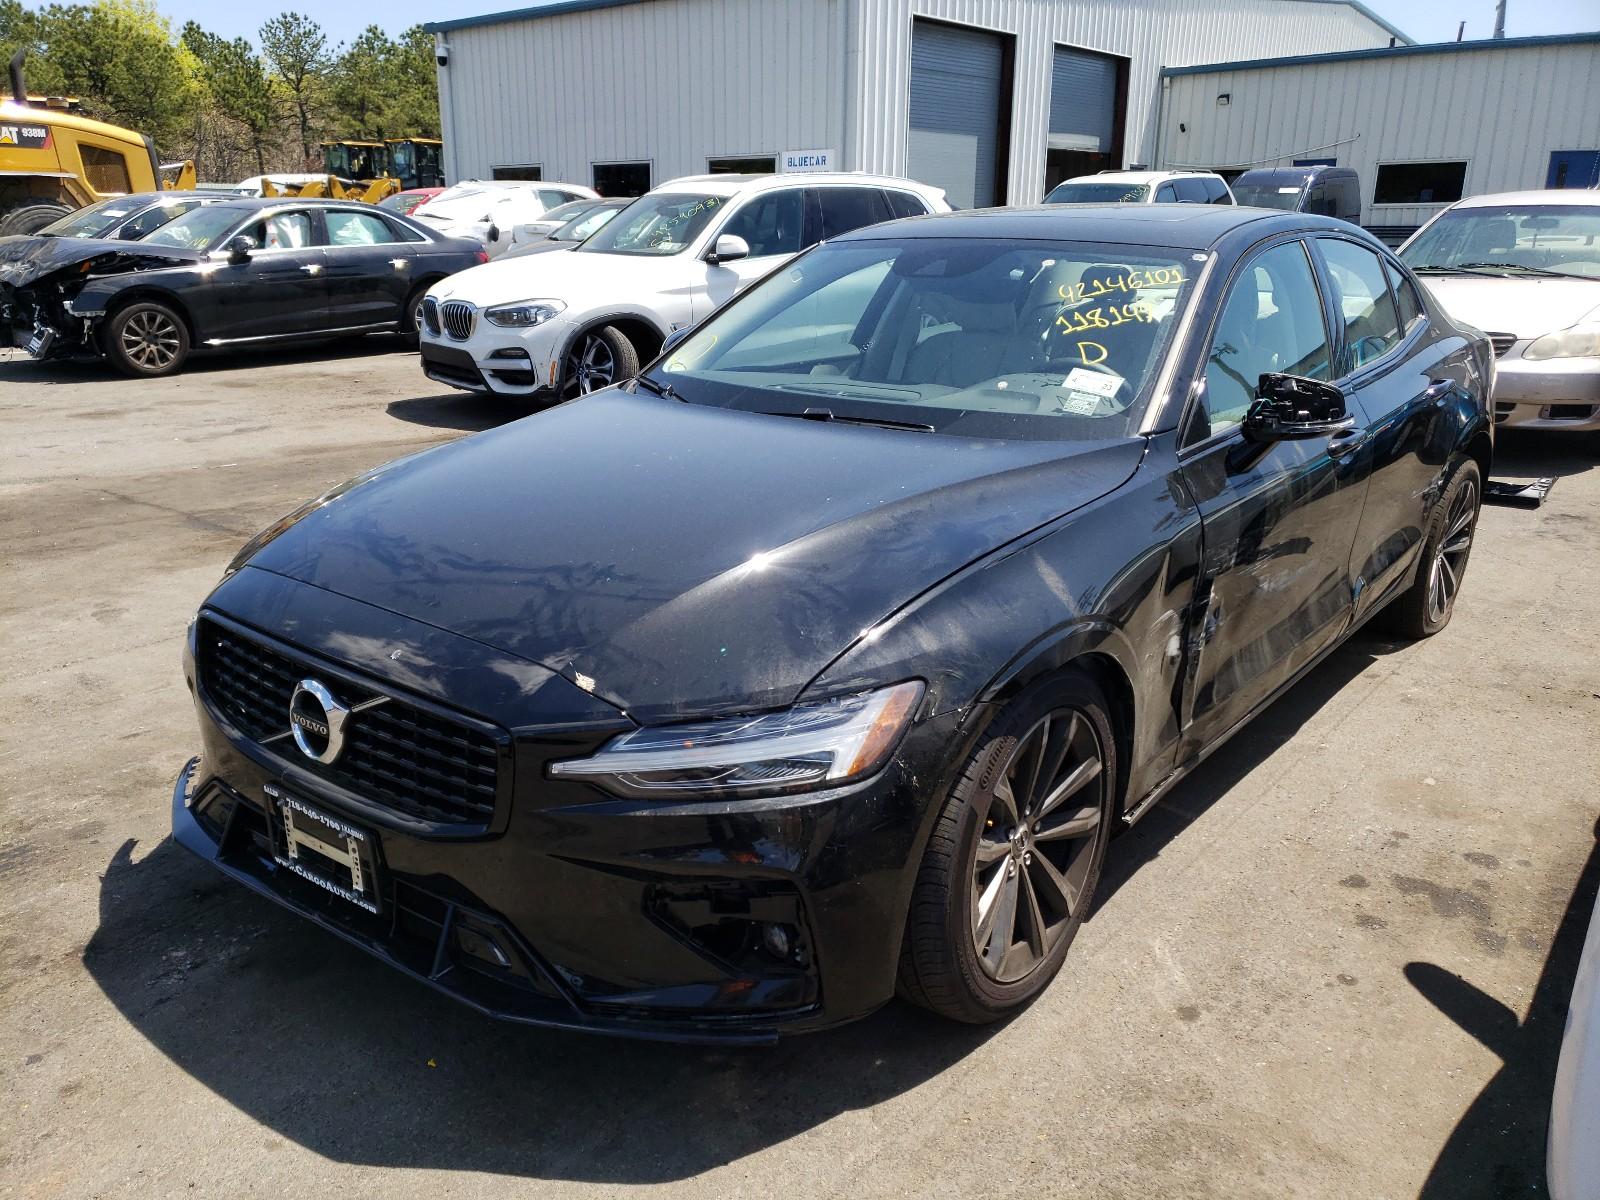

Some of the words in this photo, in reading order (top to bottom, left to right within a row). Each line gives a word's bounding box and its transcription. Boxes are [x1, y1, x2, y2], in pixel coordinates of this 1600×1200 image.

[0, 126, 18, 144] AT
[22, 127, 46, 138] 938M
[787, 155, 827, 167] BLUECAR
[1058, 269, 1190, 303] 42146101
[1077, 341, 1108, 365] D
[292, 712, 327, 735] VOLVO
